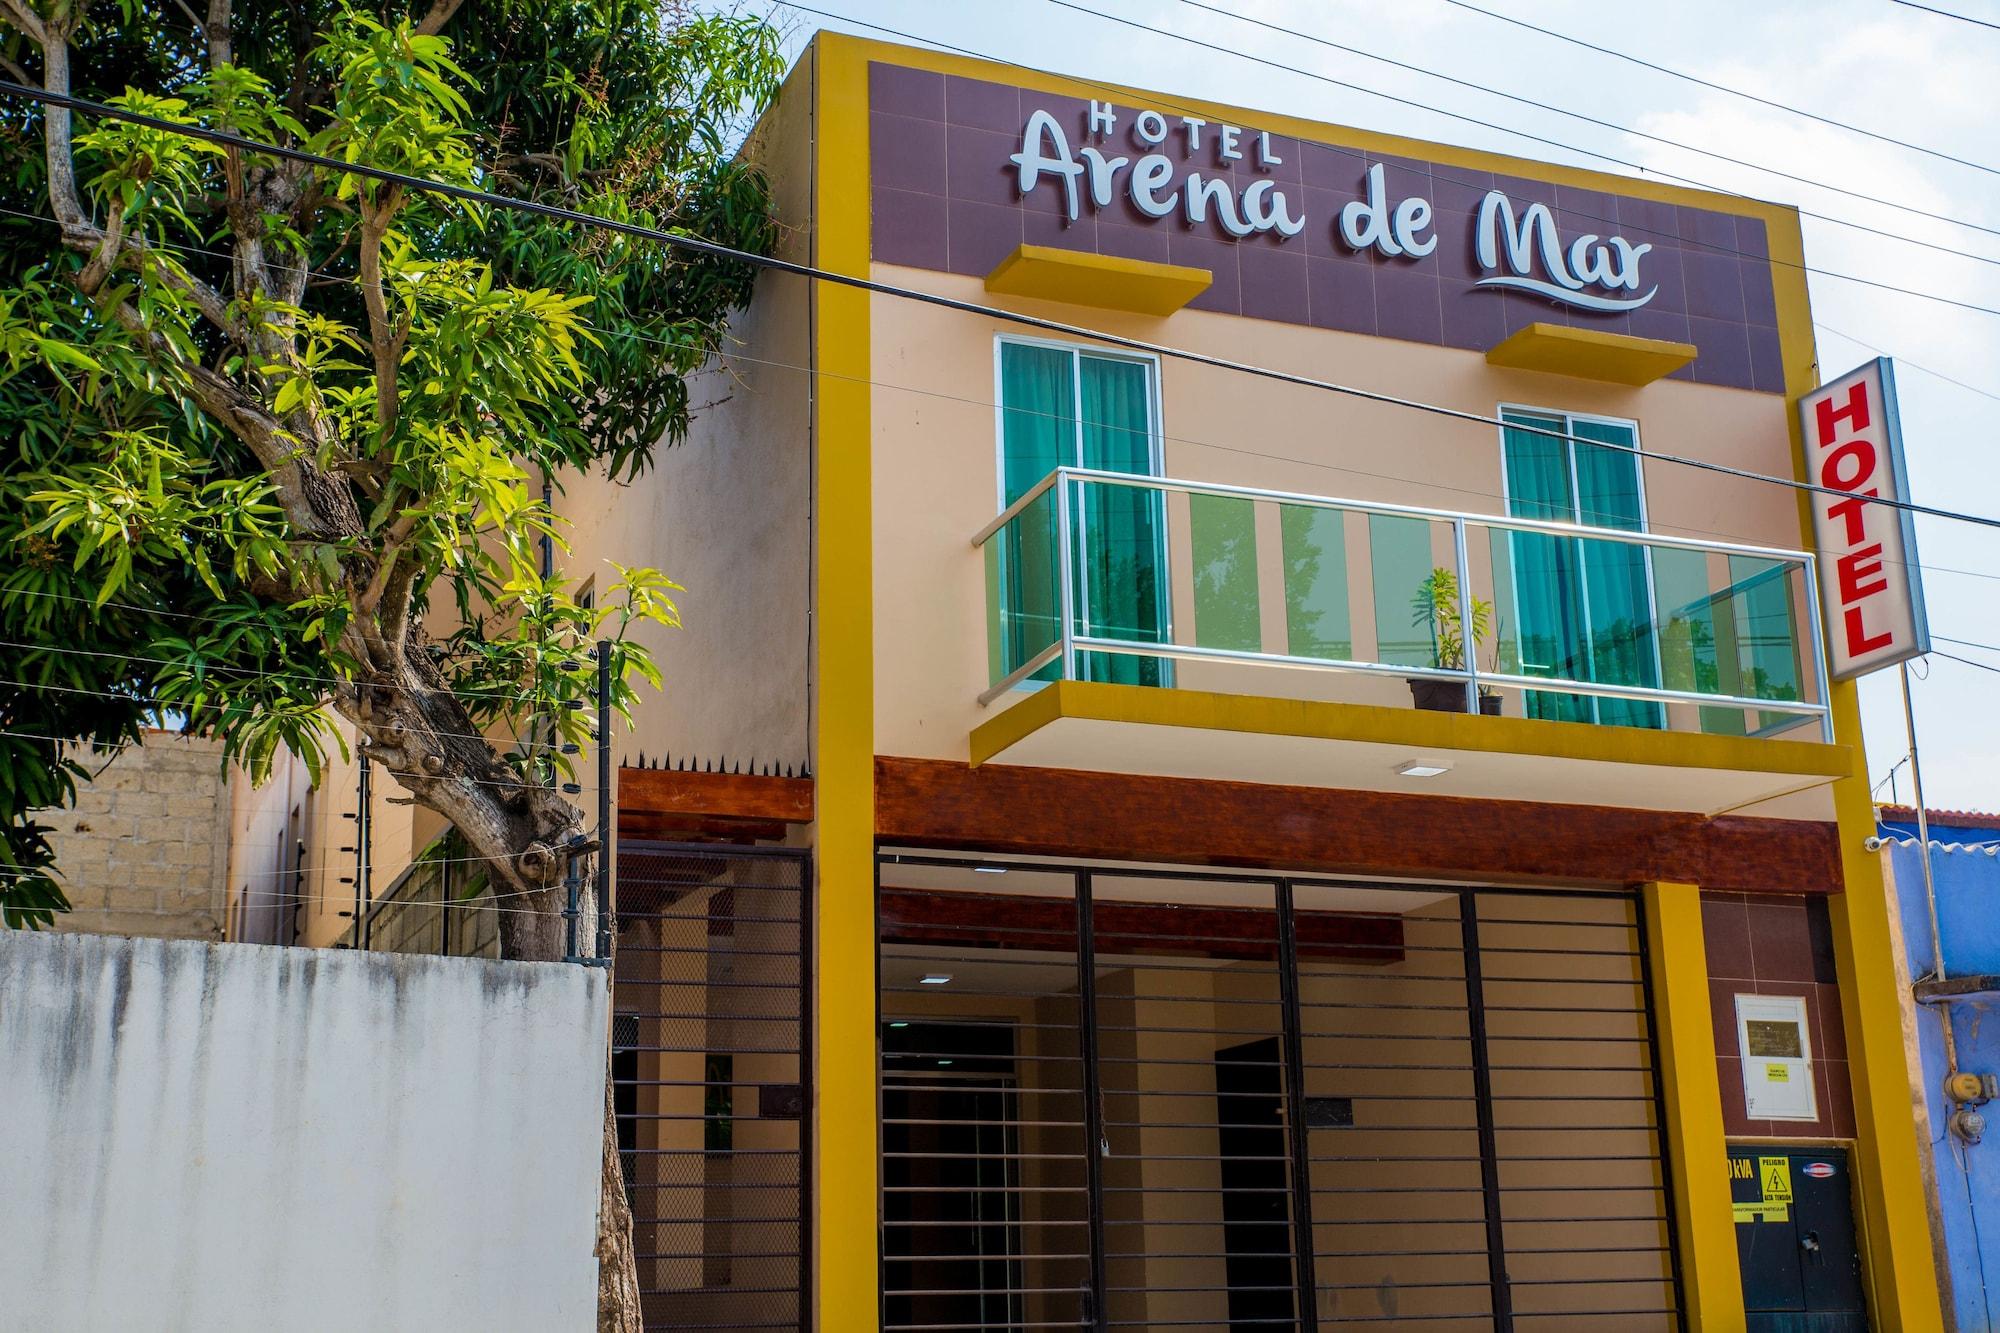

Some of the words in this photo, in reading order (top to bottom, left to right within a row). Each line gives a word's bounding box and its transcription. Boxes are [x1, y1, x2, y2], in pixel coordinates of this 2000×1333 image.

[1011, 109, 1306, 238] Arena
[1339, 162, 1438, 259] de
[1475, 189, 1654, 291] Mar
[1089, 98, 1282, 165] HOTEL
[1816, 381, 1893, 657] HOTEL
